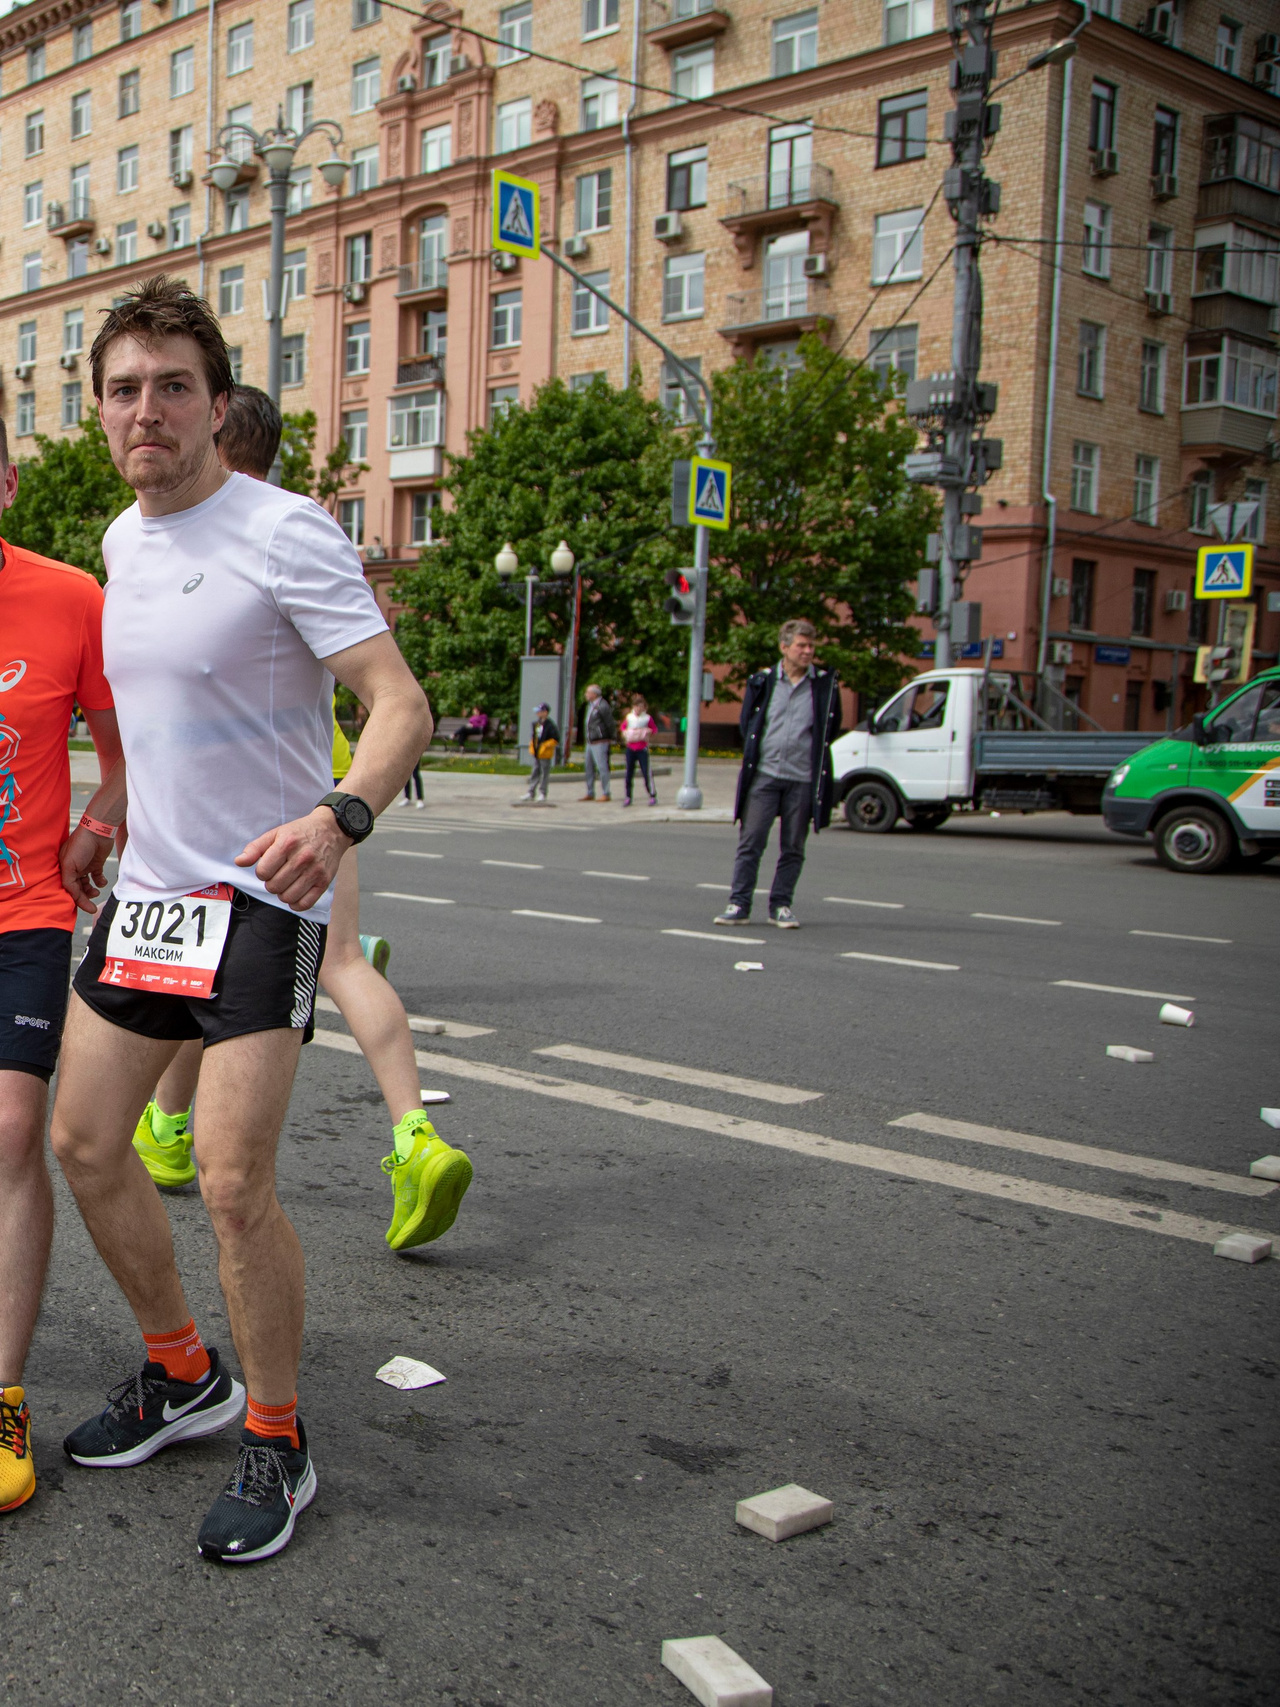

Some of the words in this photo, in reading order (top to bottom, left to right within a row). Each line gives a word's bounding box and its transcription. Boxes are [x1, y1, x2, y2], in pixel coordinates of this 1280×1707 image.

[121, 901, 207, 947] 3021
[134, 945, 184, 962] МАКСИМ
[14, 1015, 50, 1030] SPORT
